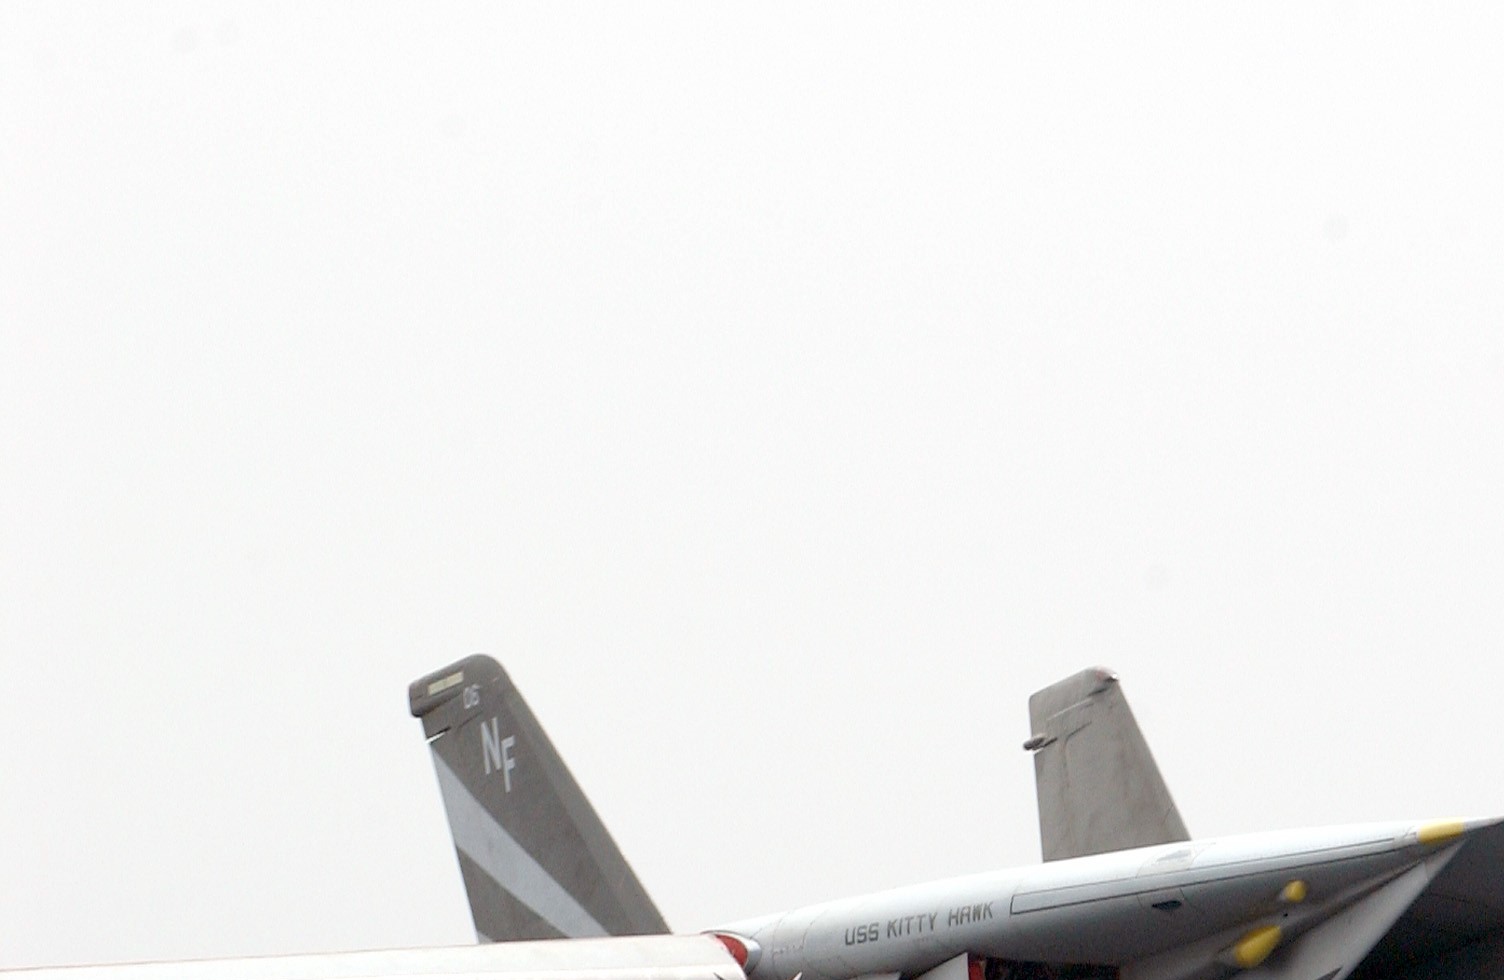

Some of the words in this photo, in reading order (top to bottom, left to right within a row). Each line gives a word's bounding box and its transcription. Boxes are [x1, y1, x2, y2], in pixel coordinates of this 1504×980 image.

[480, 716, 516, 793] NF
[844, 922, 880, 946] USS
[886, 912, 938, 939] KITTY
[948, 901, 994, 928] HAWK
